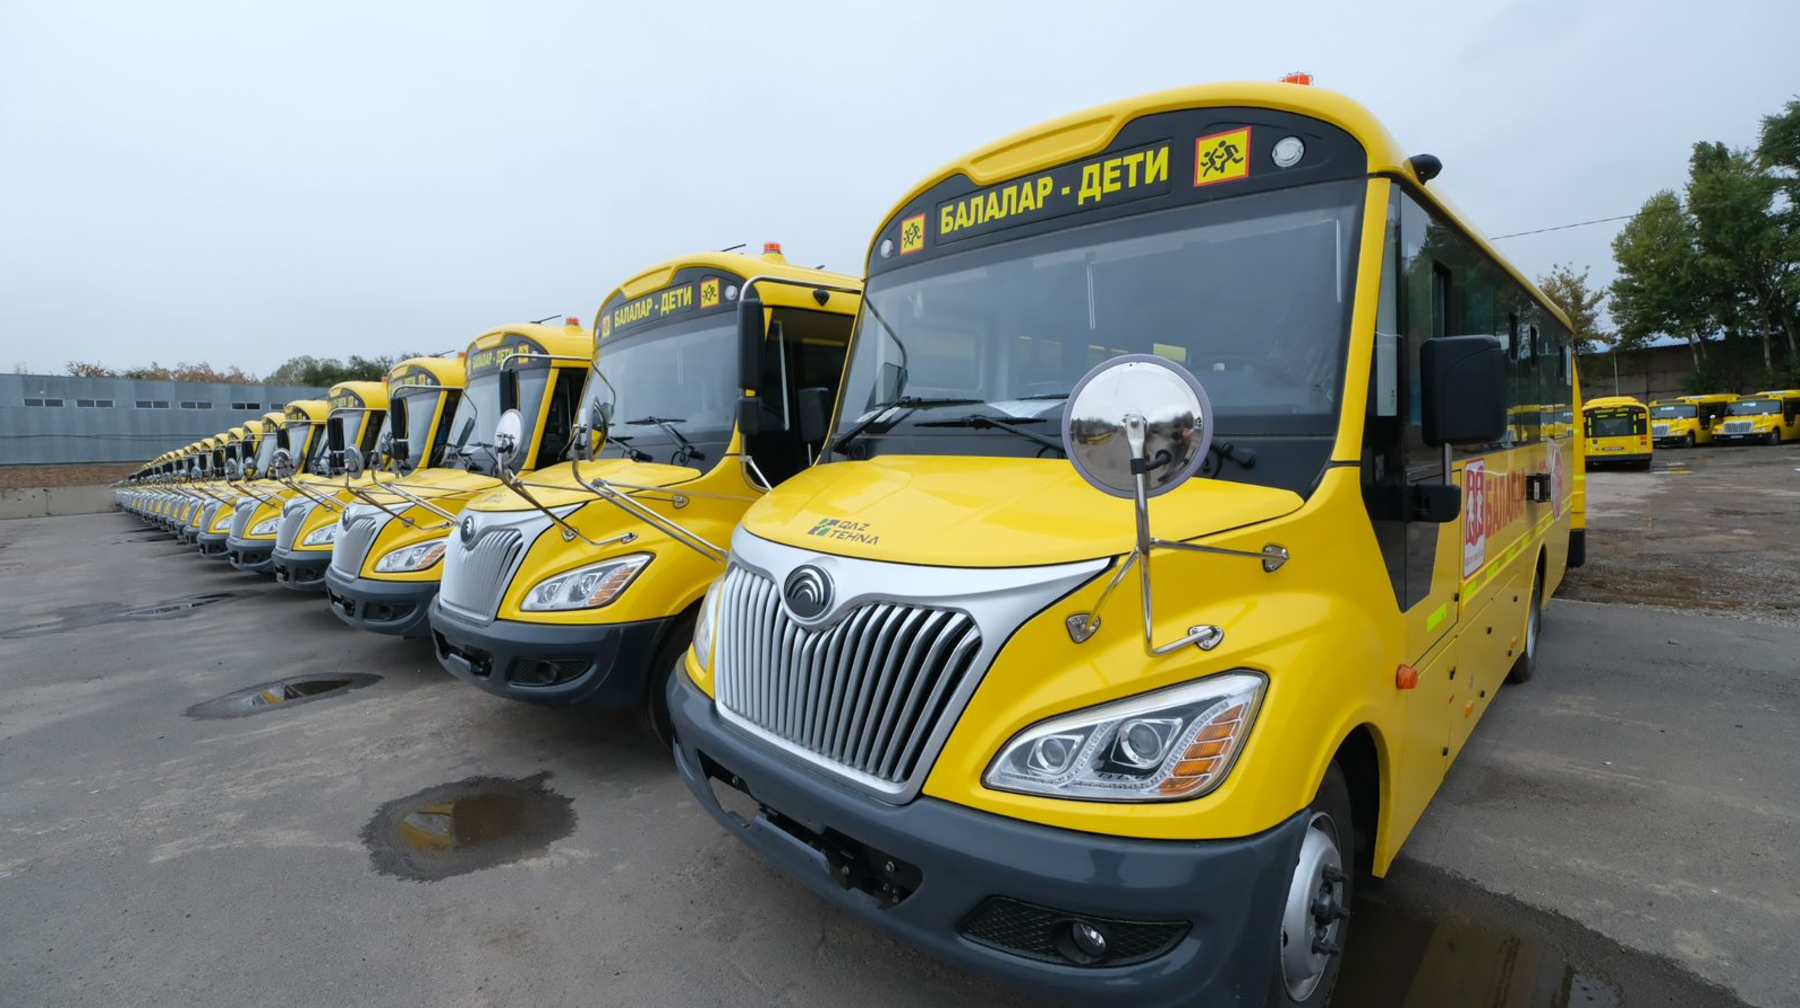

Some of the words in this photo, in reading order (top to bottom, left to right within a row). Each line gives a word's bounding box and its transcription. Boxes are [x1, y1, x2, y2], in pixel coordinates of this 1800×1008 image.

[940, 176, 1053, 235] БАЛАЛАР
[1078, 146, 1169, 205] ДЕТИ
[614, 298, 653, 328] БАЛАЛАР
[660, 286, 692, 316] ДЕТИ
[829, 529, 880, 545] TEHNA
[838, 520, 871, 531] QAZ
